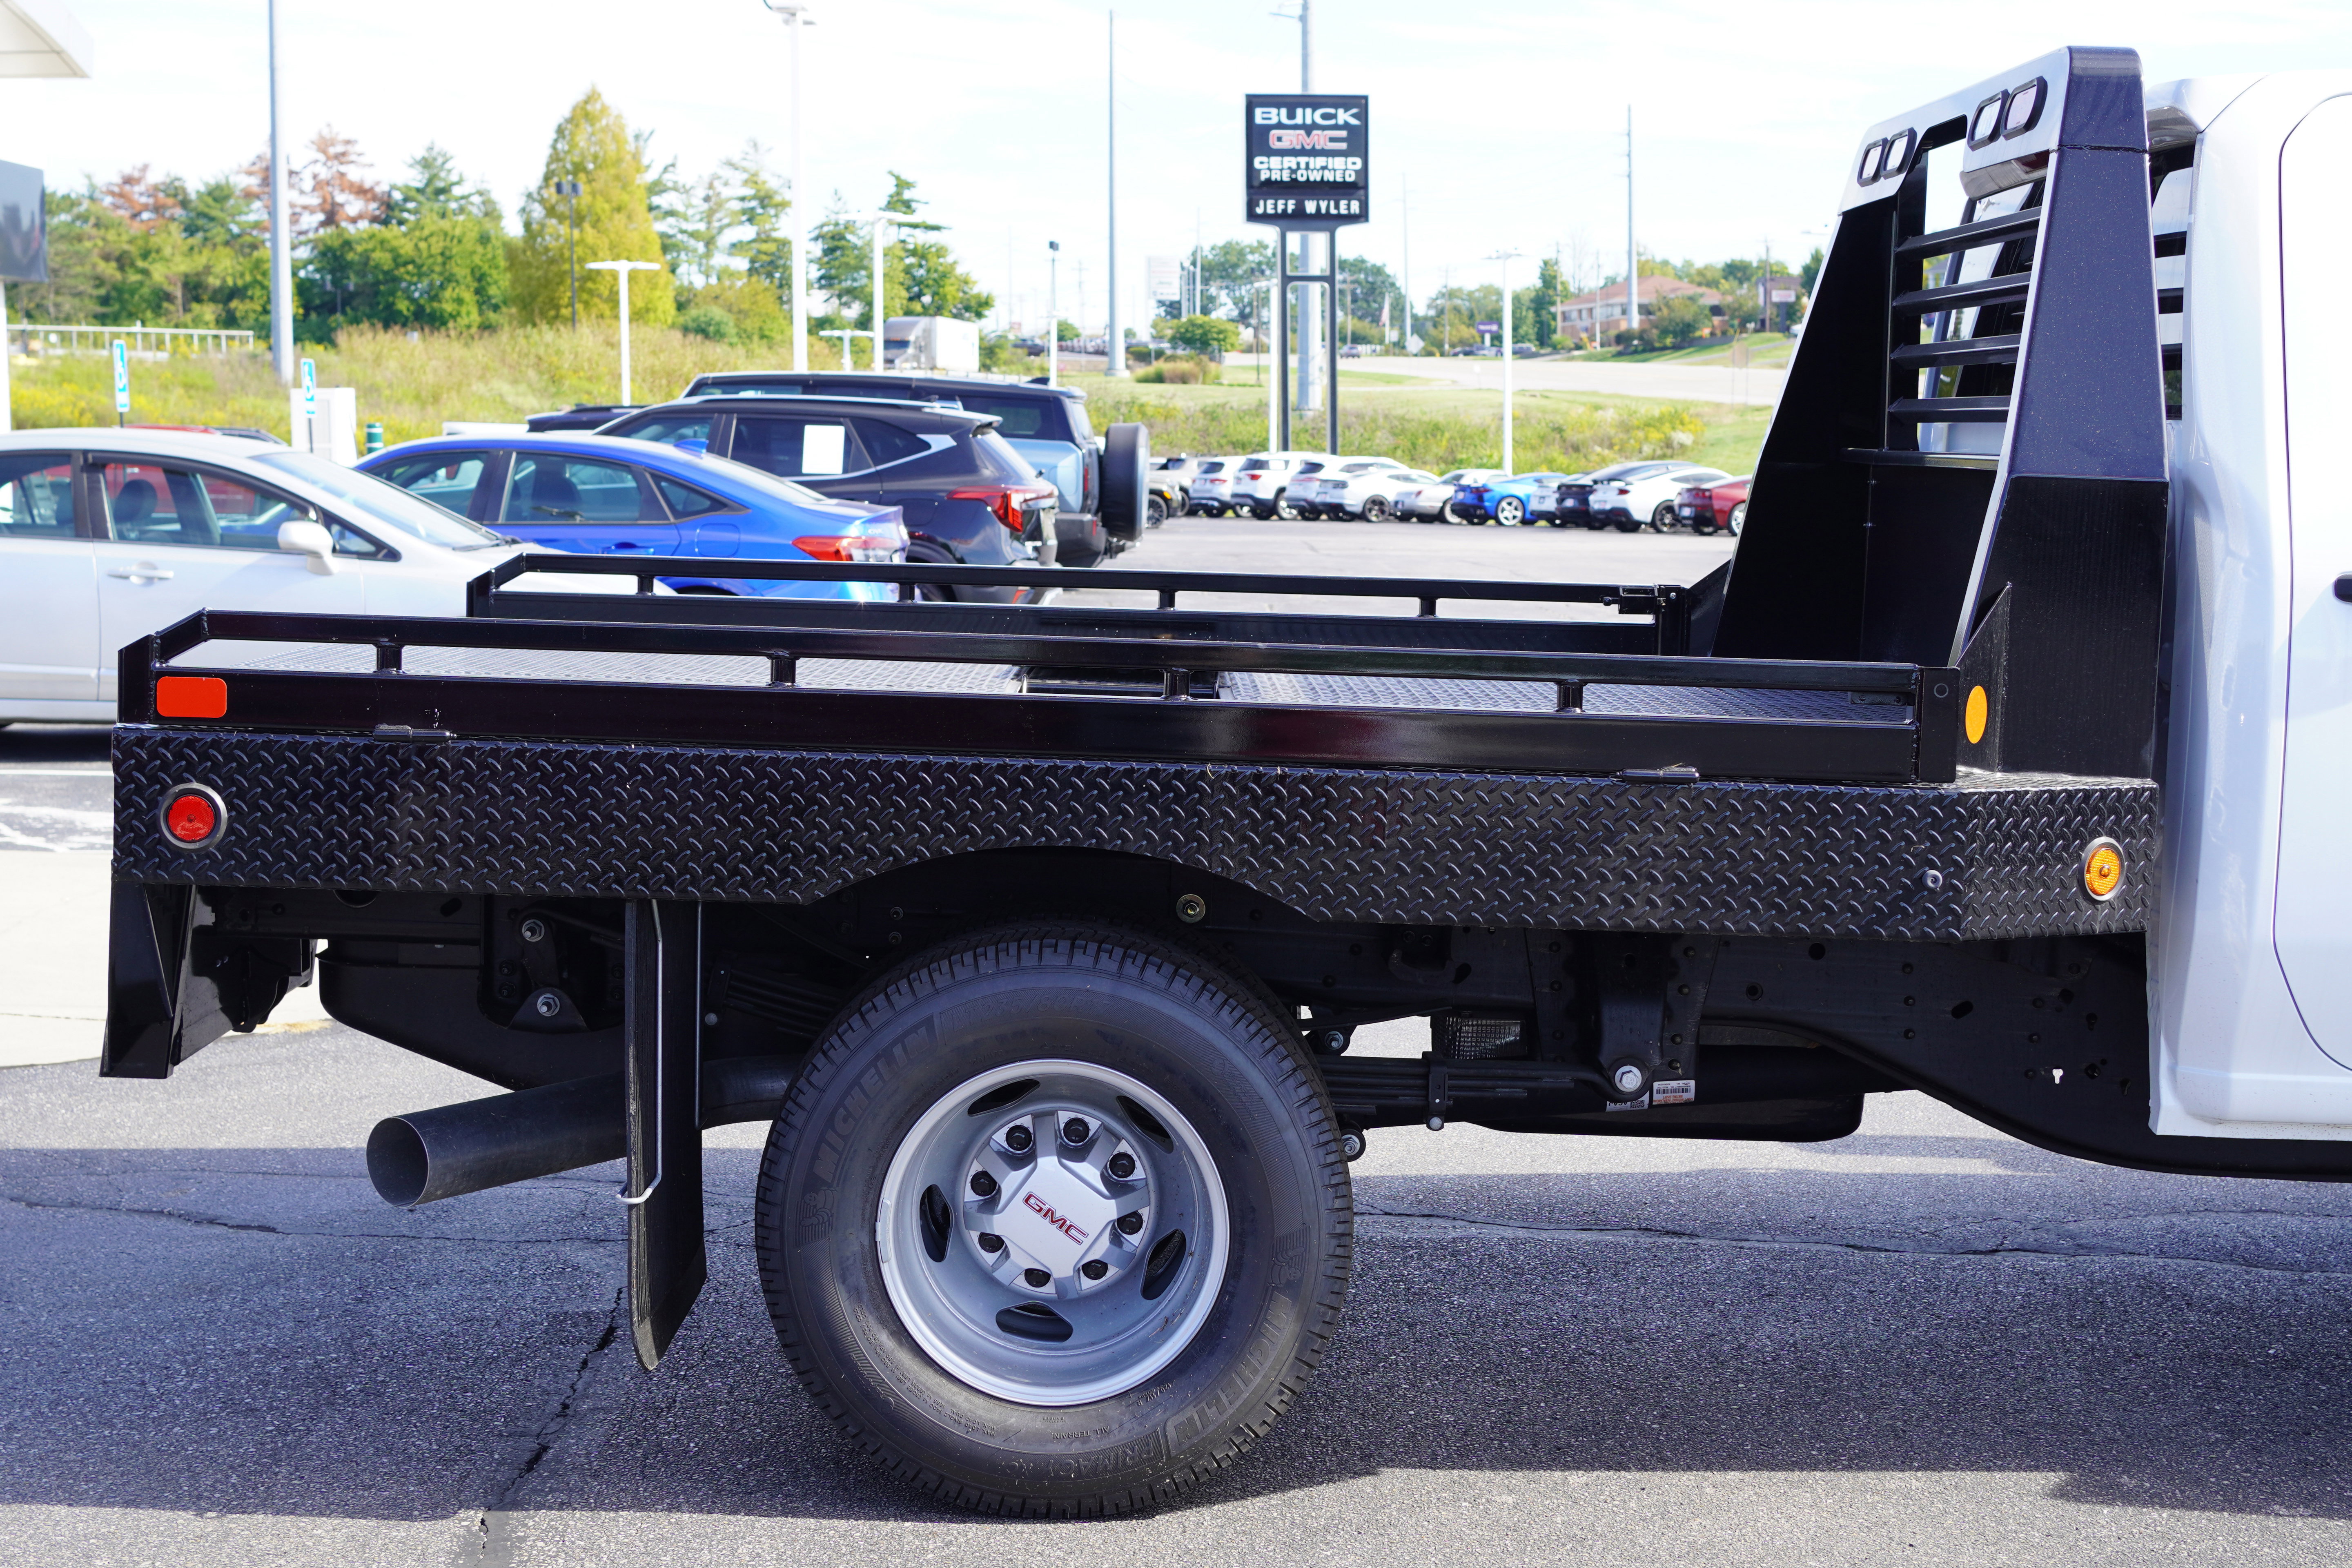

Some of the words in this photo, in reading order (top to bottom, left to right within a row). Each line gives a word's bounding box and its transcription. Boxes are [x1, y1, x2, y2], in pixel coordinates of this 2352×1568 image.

[1254, 107, 1361, 125] BUICK
[1269, 129, 1348, 149] GMC
[1254, 156, 1362, 170] CERTIFIED
[1260, 169, 1356, 181] PRE-OWNED
[1255, 199, 1296, 214] JEFF
[1305, 199, 1360, 214] WYLER
[811, 1022, 935, 1183] MICHELIN
[1022, 1192, 1089, 1246] GMC
[1168, 1291, 1295, 1446] MICHELIN
[928, 1402, 943, 1414] 1400
[949, 1408, 964, 1419] DUAL
[943, 1411, 964, 1425] SINGLE
[965, 1416, 980, 1426] LOAD
[964, 1421, 979, 1432] LOAD
[1092, 1425, 1110, 1435] ALL
[1054, 1429, 1091, 1439] TERRAIN
[1042, 1439, 1158, 1478] PRIMACY
